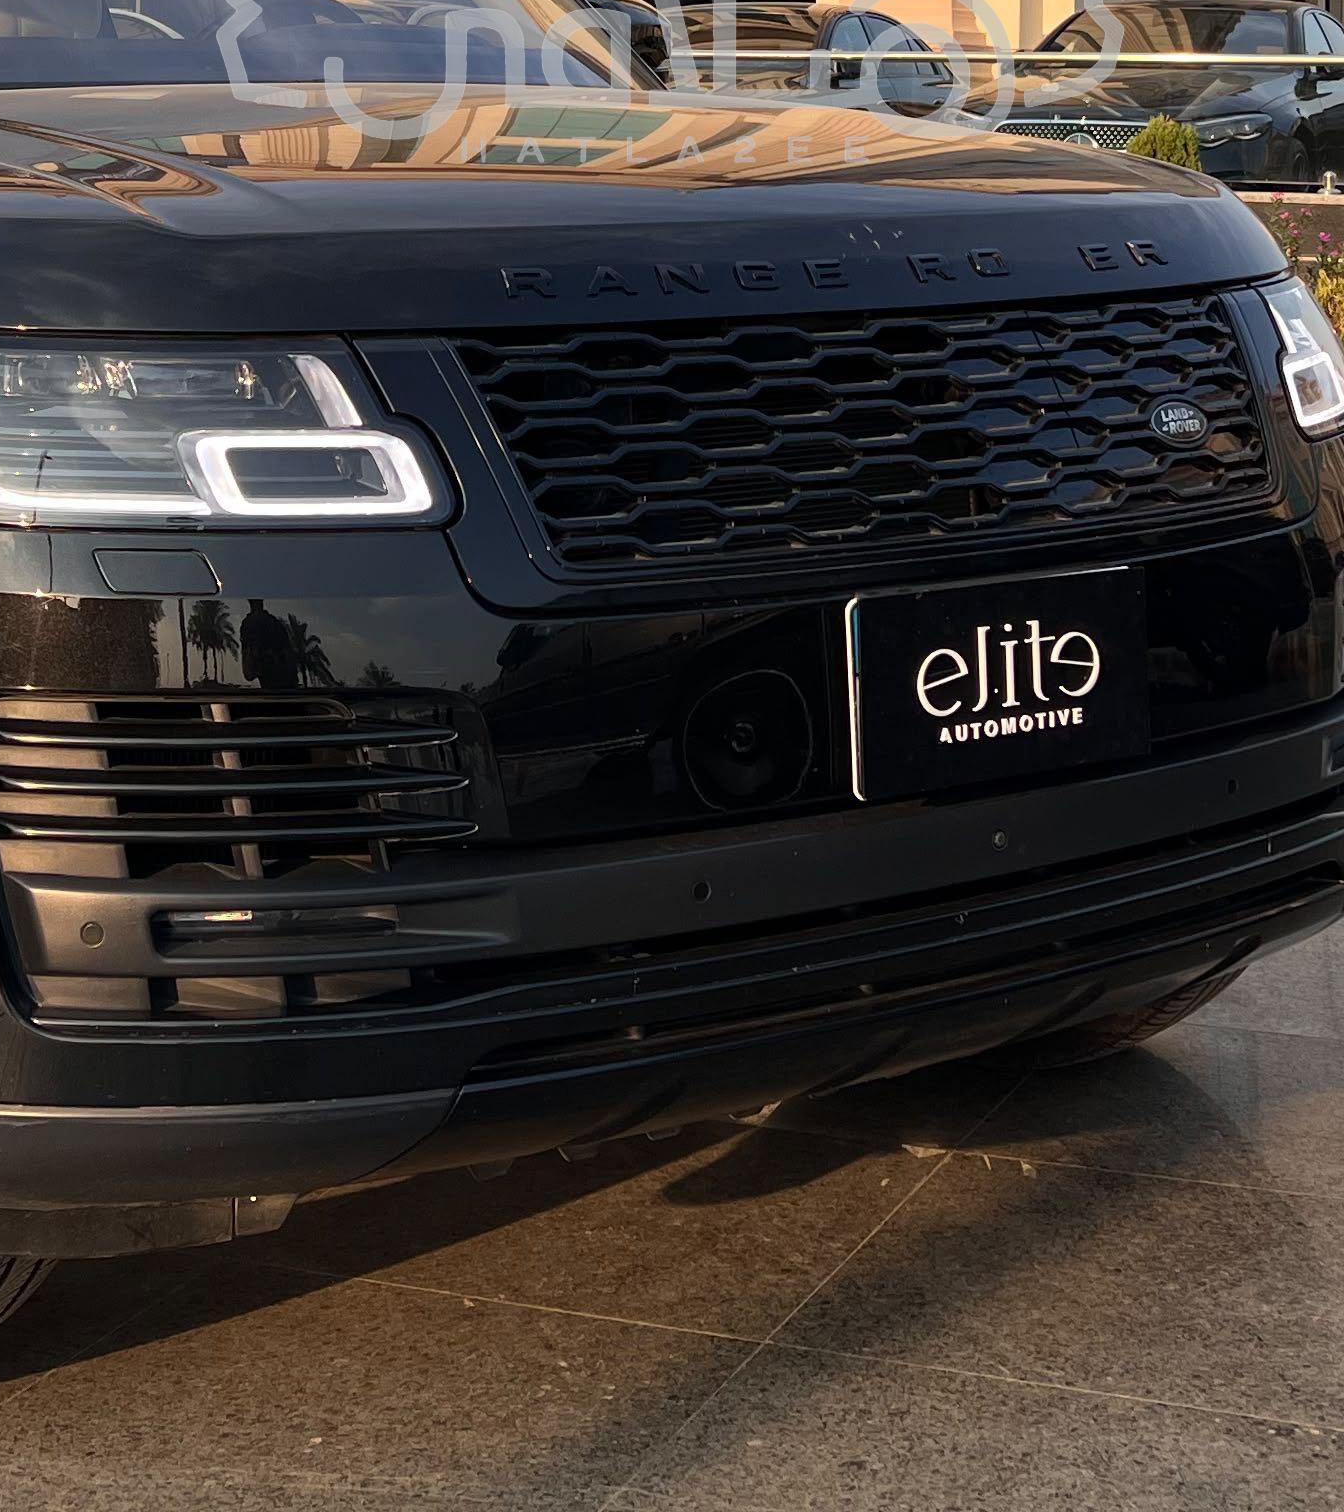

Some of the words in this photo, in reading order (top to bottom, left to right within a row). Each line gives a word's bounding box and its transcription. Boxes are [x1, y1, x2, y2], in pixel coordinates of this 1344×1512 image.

[499, 259, 850, 299] RANGE
[905, 239, 1170, 284] ROER
[1161, 407, 1189, 422] LAND
[1169, 419, 1201, 435] ROVER
[916, 620, 1100, 717] elite
[939, 707, 1083, 744] AUTOMOTIVE
